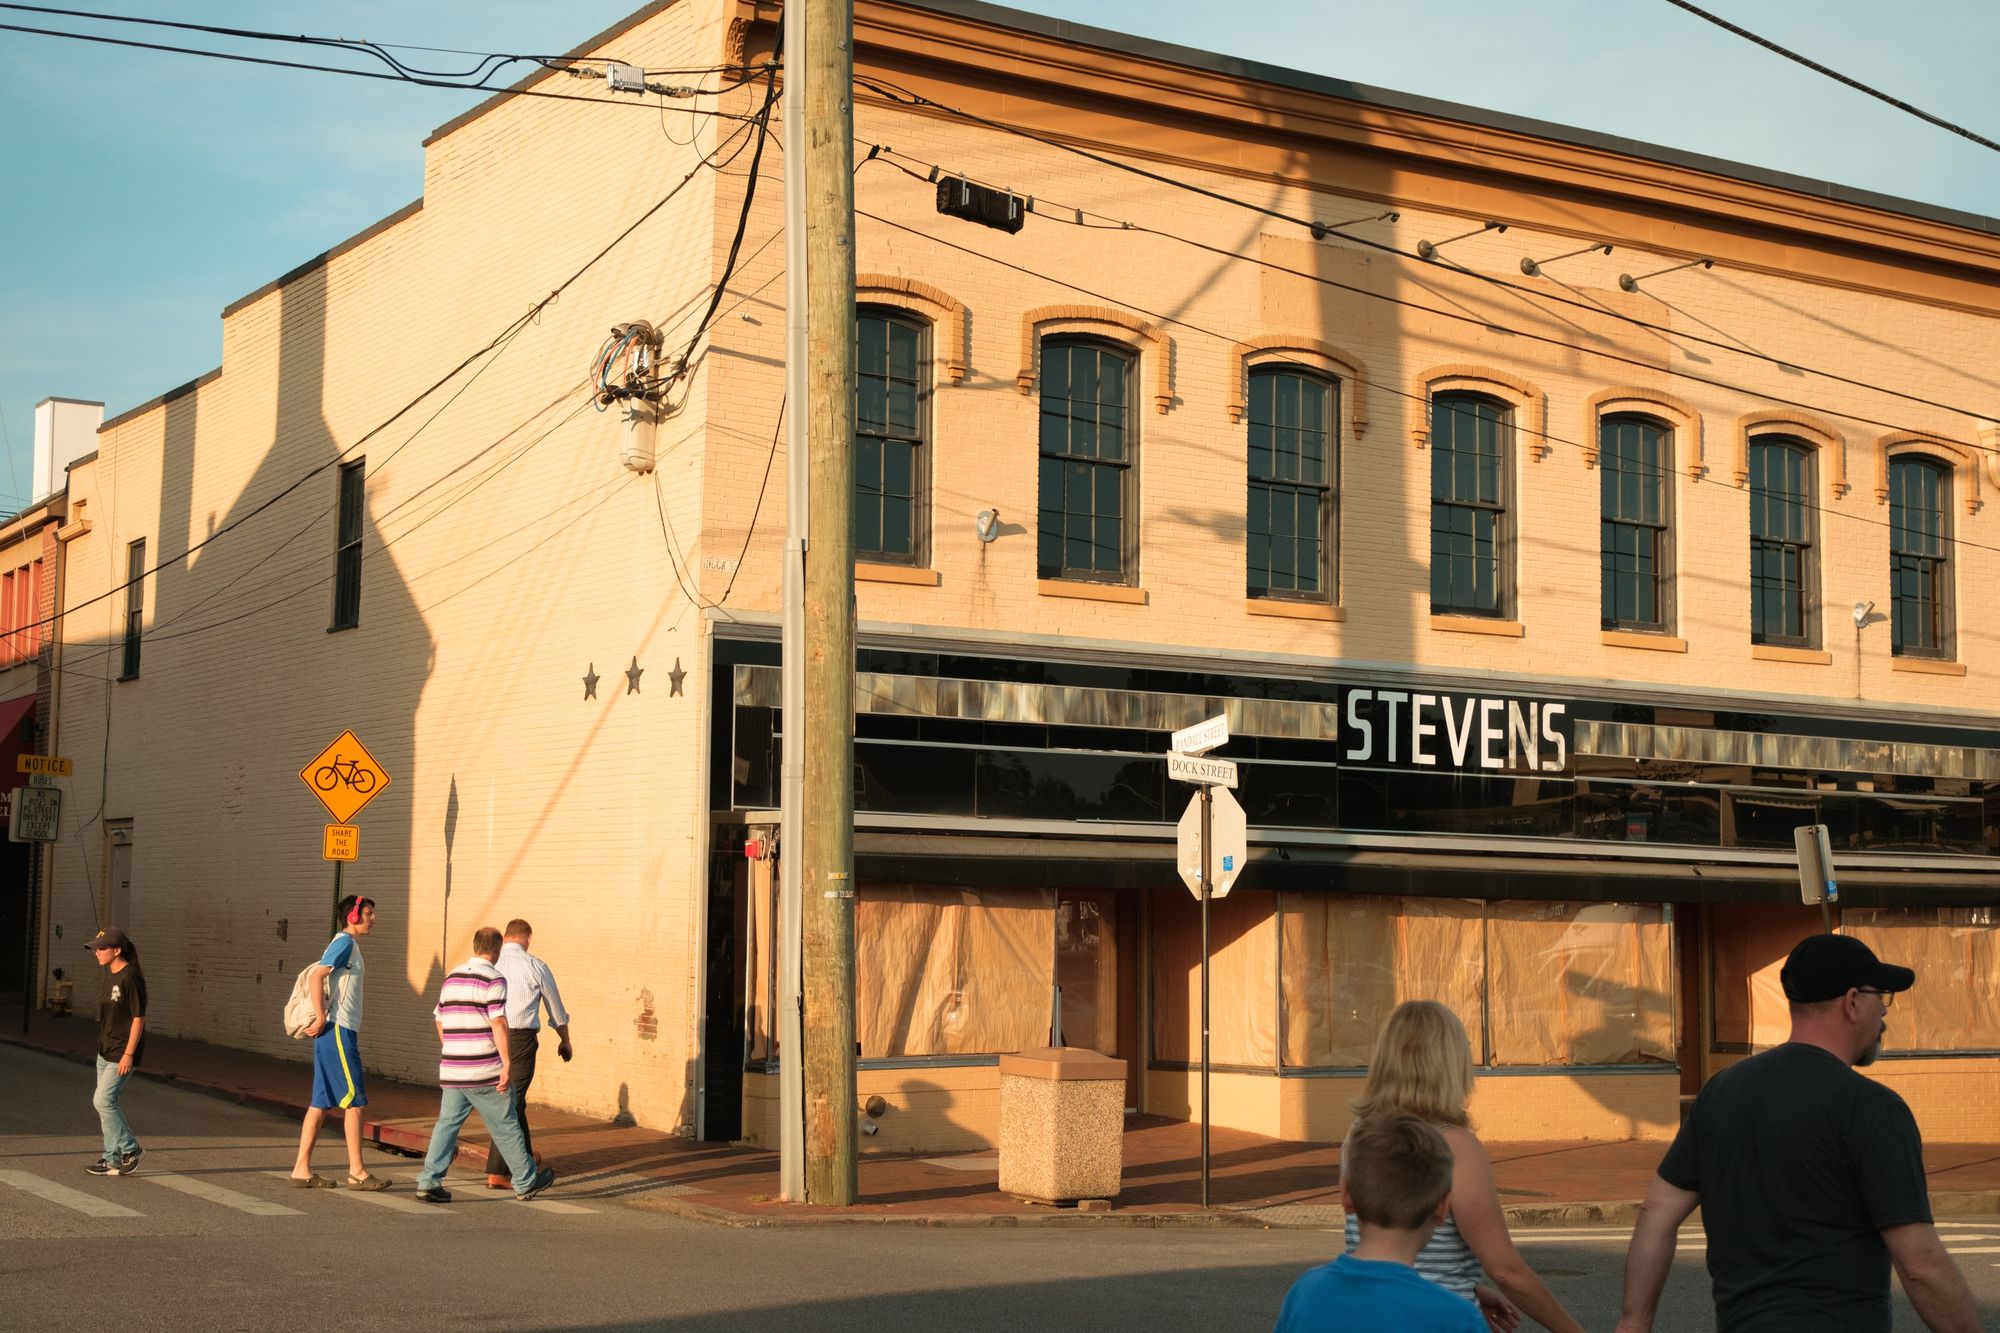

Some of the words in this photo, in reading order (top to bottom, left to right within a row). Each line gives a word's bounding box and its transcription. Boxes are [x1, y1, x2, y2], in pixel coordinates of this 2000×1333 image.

[1347, 689, 1566, 771] STEVENS
[1175, 732, 1203, 752] RANDALL
[1203, 723, 1225, 742] STREET
[25, 758, 65, 773] NOTICE
[1172, 759, 1198, 775] DOCK
[1200, 763, 1234, 780] STREET
[36, 790, 45, 798] NO
[28, 798, 48, 807] BUSES
[33, 805, 56, 815] STREET
[27, 821, 50, 831] EXCEPT
[331, 829, 352, 838] SHARE
[336, 838, 347, 847] THE
[331, 847, 350, 856] ROAD
